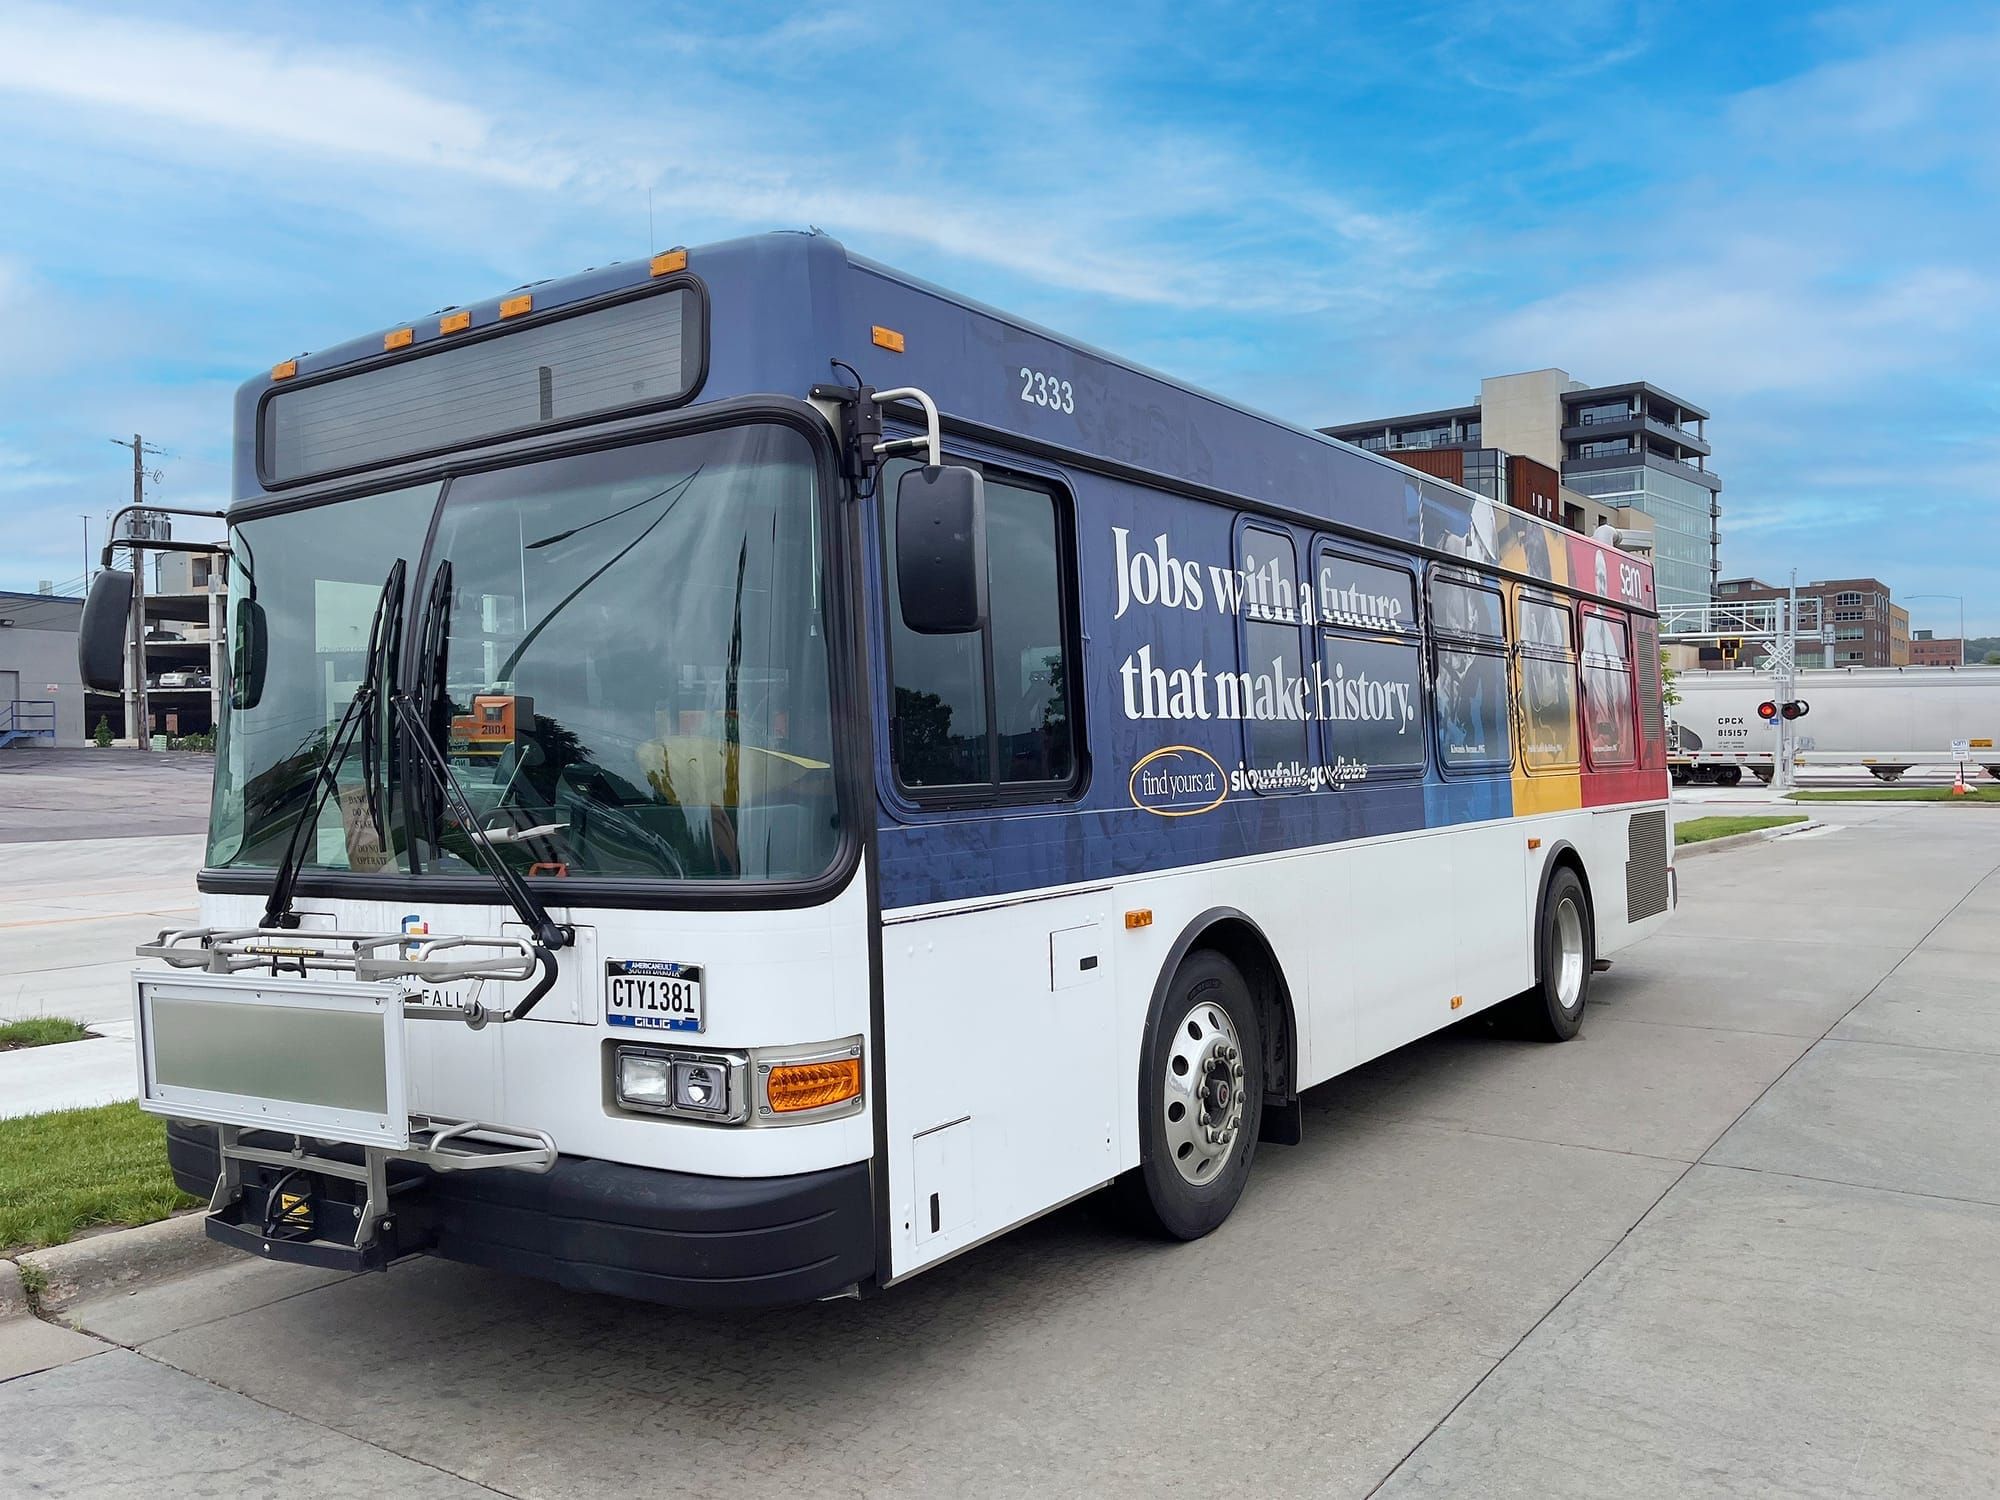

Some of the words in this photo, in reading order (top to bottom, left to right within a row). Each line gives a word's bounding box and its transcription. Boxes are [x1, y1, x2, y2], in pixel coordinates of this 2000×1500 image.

[1020, 367, 1074, 414] 2333
[1112, 527, 1204, 620] Jobs
[1208, 555, 1296, 622] with
[1301, 582, 1319, 626] a
[1320, 567, 1407, 634] future
[1620, 563, 1642, 600] sam
[1119, 644, 1212, 720] that
[1214, 656, 1312, 721] make
[1311, 660, 1414, 735] history.
[1718, 717, 1744, 725] CPCX
[1718, 729, 1748, 737] 815157
[1142, 770, 1169, 796] find
[1169, 775, 1204, 799] yours
[1203, 772, 1216, 792] at
[613, 978, 695, 1013] CTY1381
[634, 1016, 671, 1029] GILLIG
